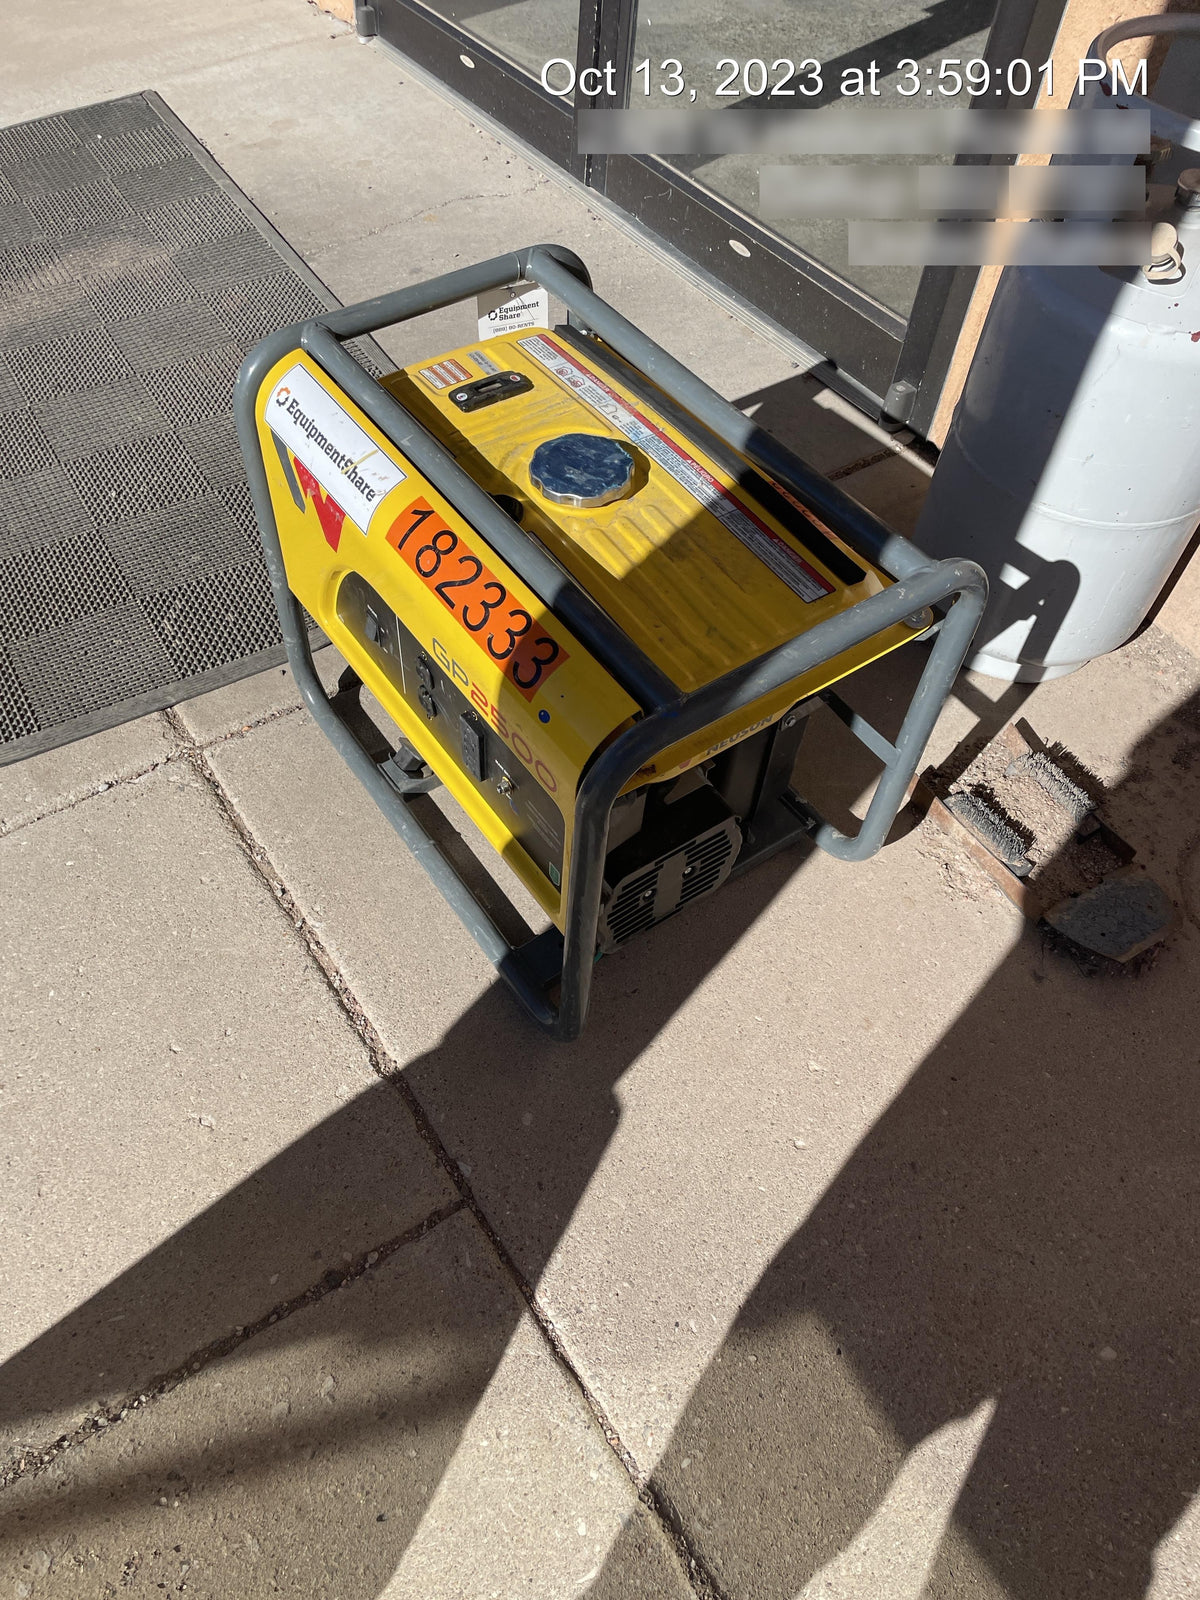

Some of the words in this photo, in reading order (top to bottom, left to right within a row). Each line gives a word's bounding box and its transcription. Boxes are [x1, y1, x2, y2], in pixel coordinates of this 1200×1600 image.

[498, 300, 539, 315] Equipment
[498, 312, 521, 322] Share
[286, 398, 377, 502] EquipmentShare
[397, 509, 560, 690] 182333
[432, 637, 558, 794] GP2500
[704, 714, 775, 757] NEUSON
